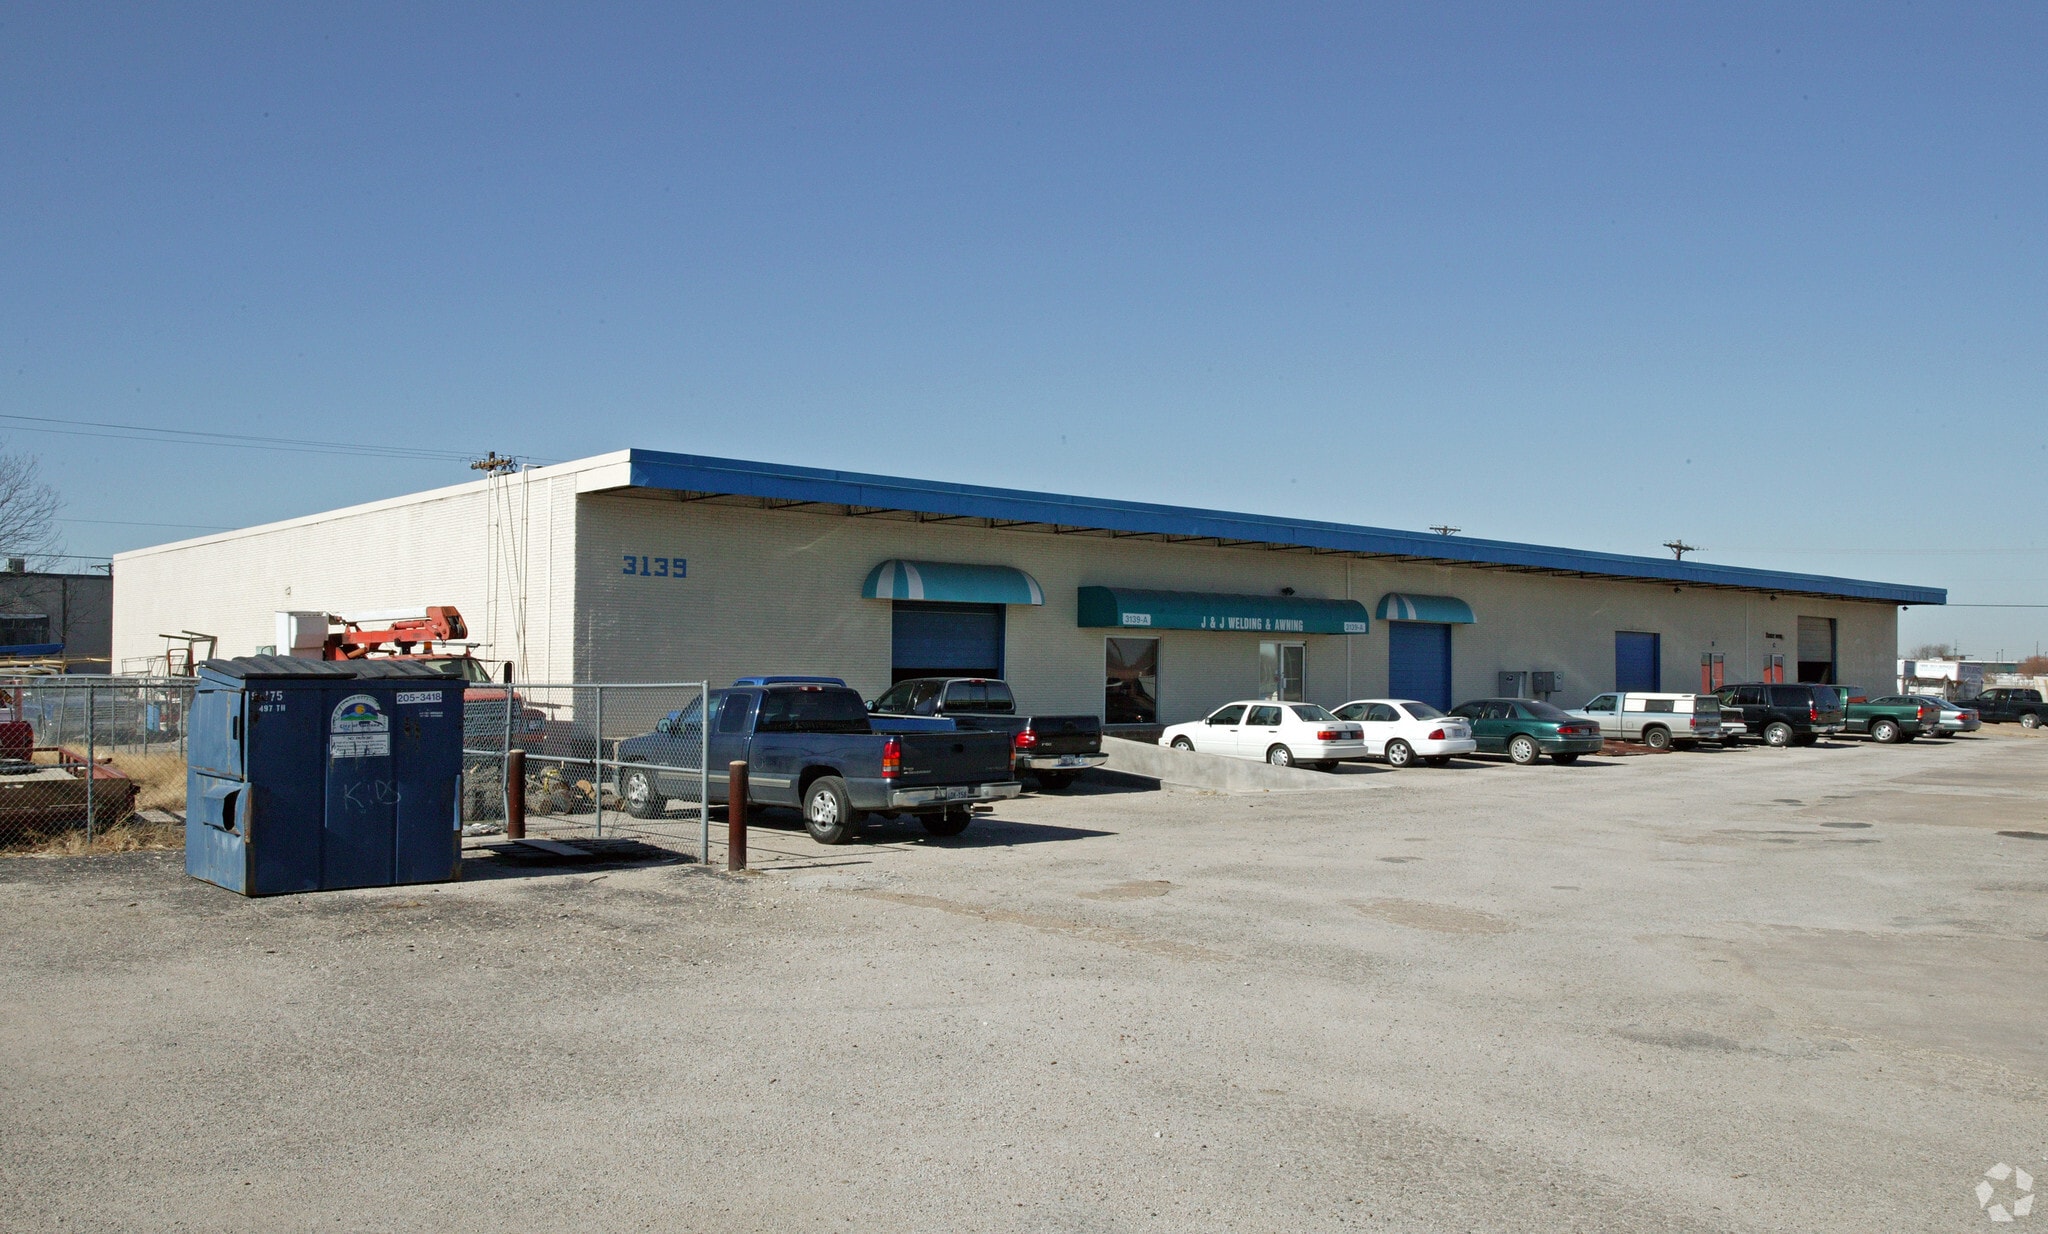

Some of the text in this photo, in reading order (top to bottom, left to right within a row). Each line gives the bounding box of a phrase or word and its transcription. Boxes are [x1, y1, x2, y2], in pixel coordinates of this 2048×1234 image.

[623, 555, 687, 578] 3139
[1125, 615, 1149, 624] 3139-A
[1201, 616, 1304, 632] J & J WELDING & AWNING
[397, 693, 441, 702] 205-3418
